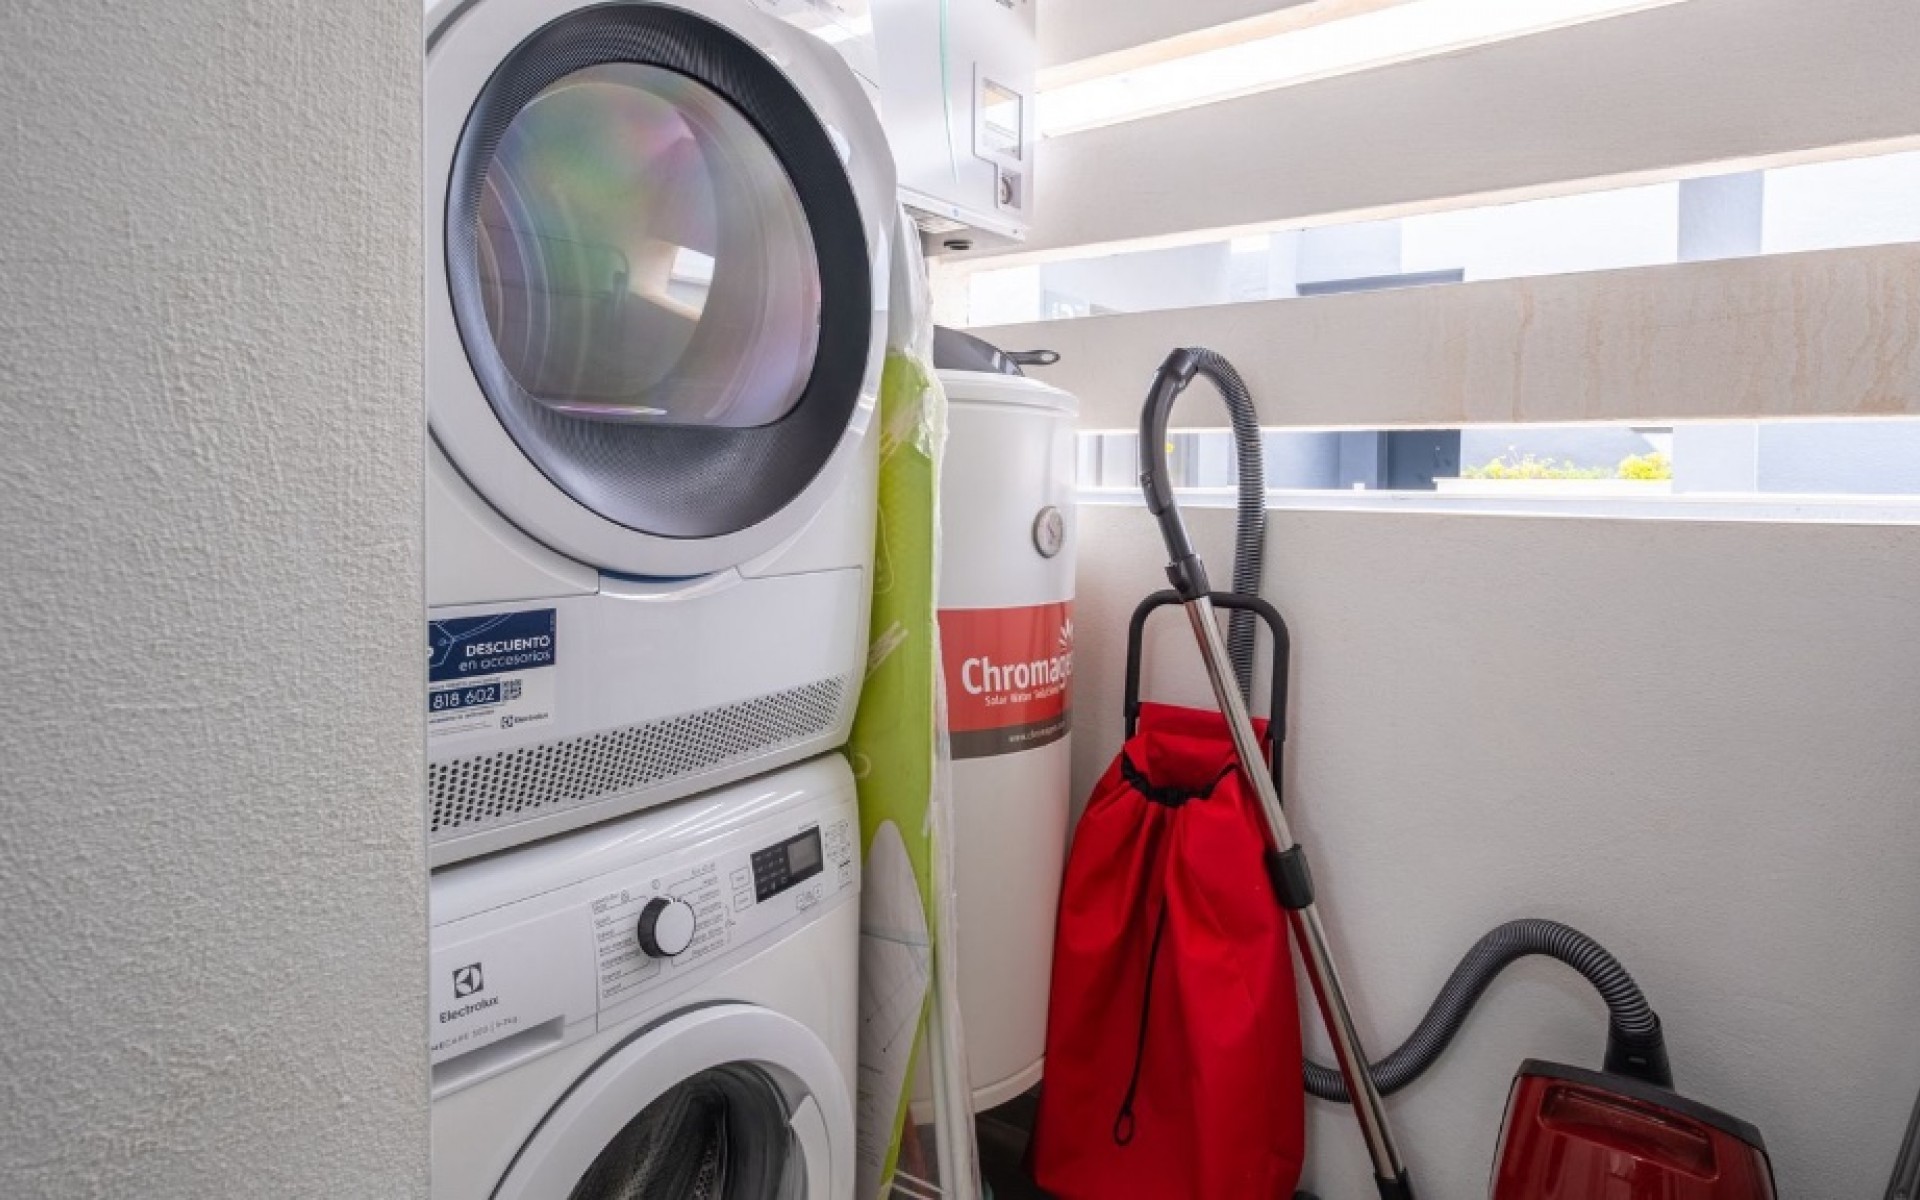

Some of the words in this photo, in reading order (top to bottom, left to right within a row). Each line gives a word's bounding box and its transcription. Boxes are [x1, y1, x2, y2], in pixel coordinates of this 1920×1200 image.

[466, 635, 550, 657] DESCUENTO
[458, 660, 478, 672] en
[481, 650, 550, 670] accesorios
[432, 691, 460, 709] 818
[464, 687, 496, 705] 602
[439, 996, 499, 1023] Electrolux
